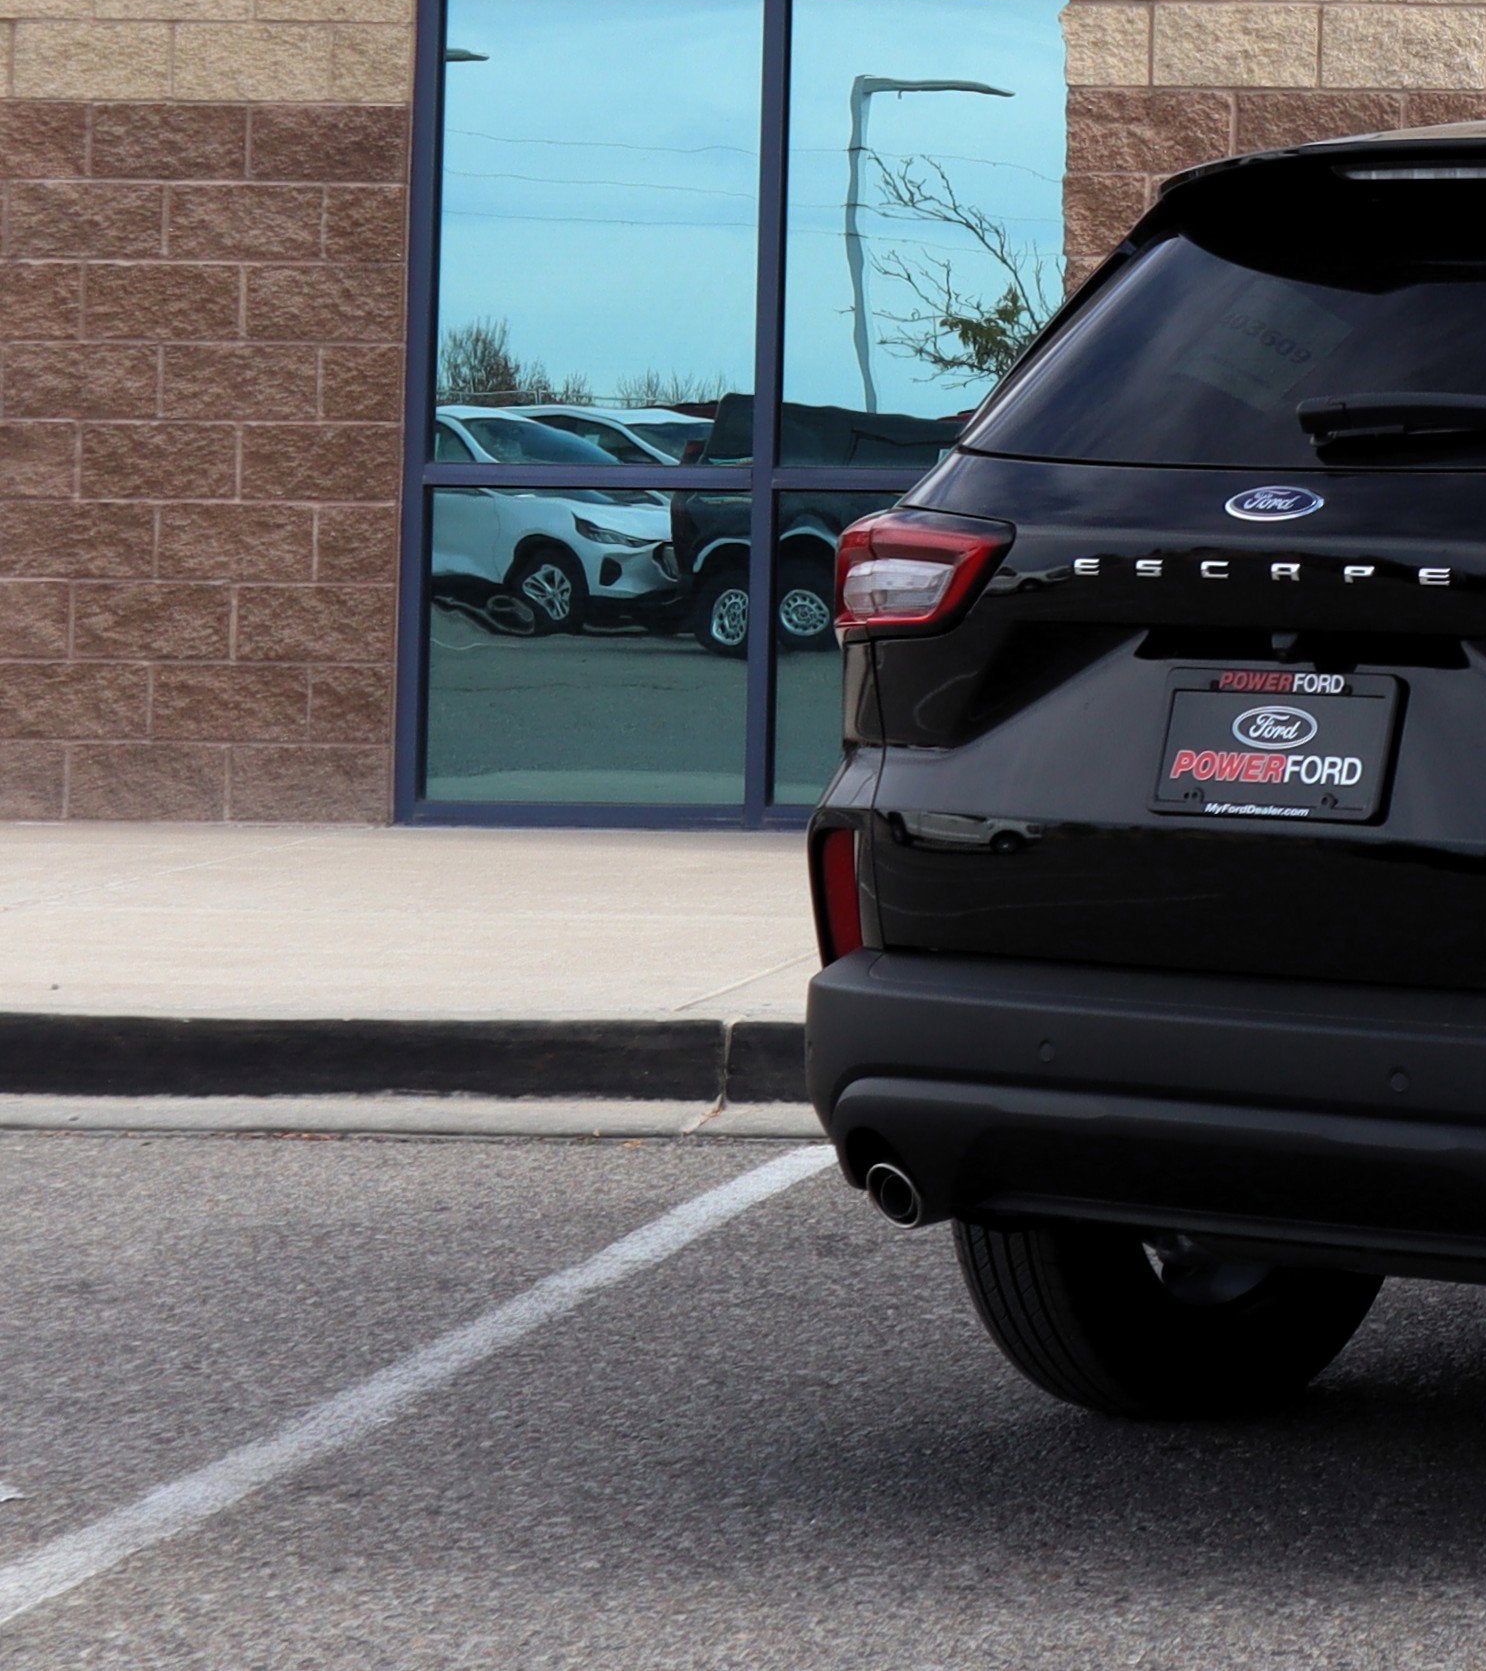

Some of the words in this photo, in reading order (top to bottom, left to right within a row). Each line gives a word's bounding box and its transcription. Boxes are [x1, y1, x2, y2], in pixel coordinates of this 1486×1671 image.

[1243, 489, 1301, 510] Ford
[1074, 558, 1451, 586] ESCAPE
[1219, 671, 1345, 693] POWERFORD
[1248, 713, 1302, 739] Ford
[1170, 749, 1363, 785] POWERFORD
[1204, 802, 1310, 817] MyFordDealer.com
